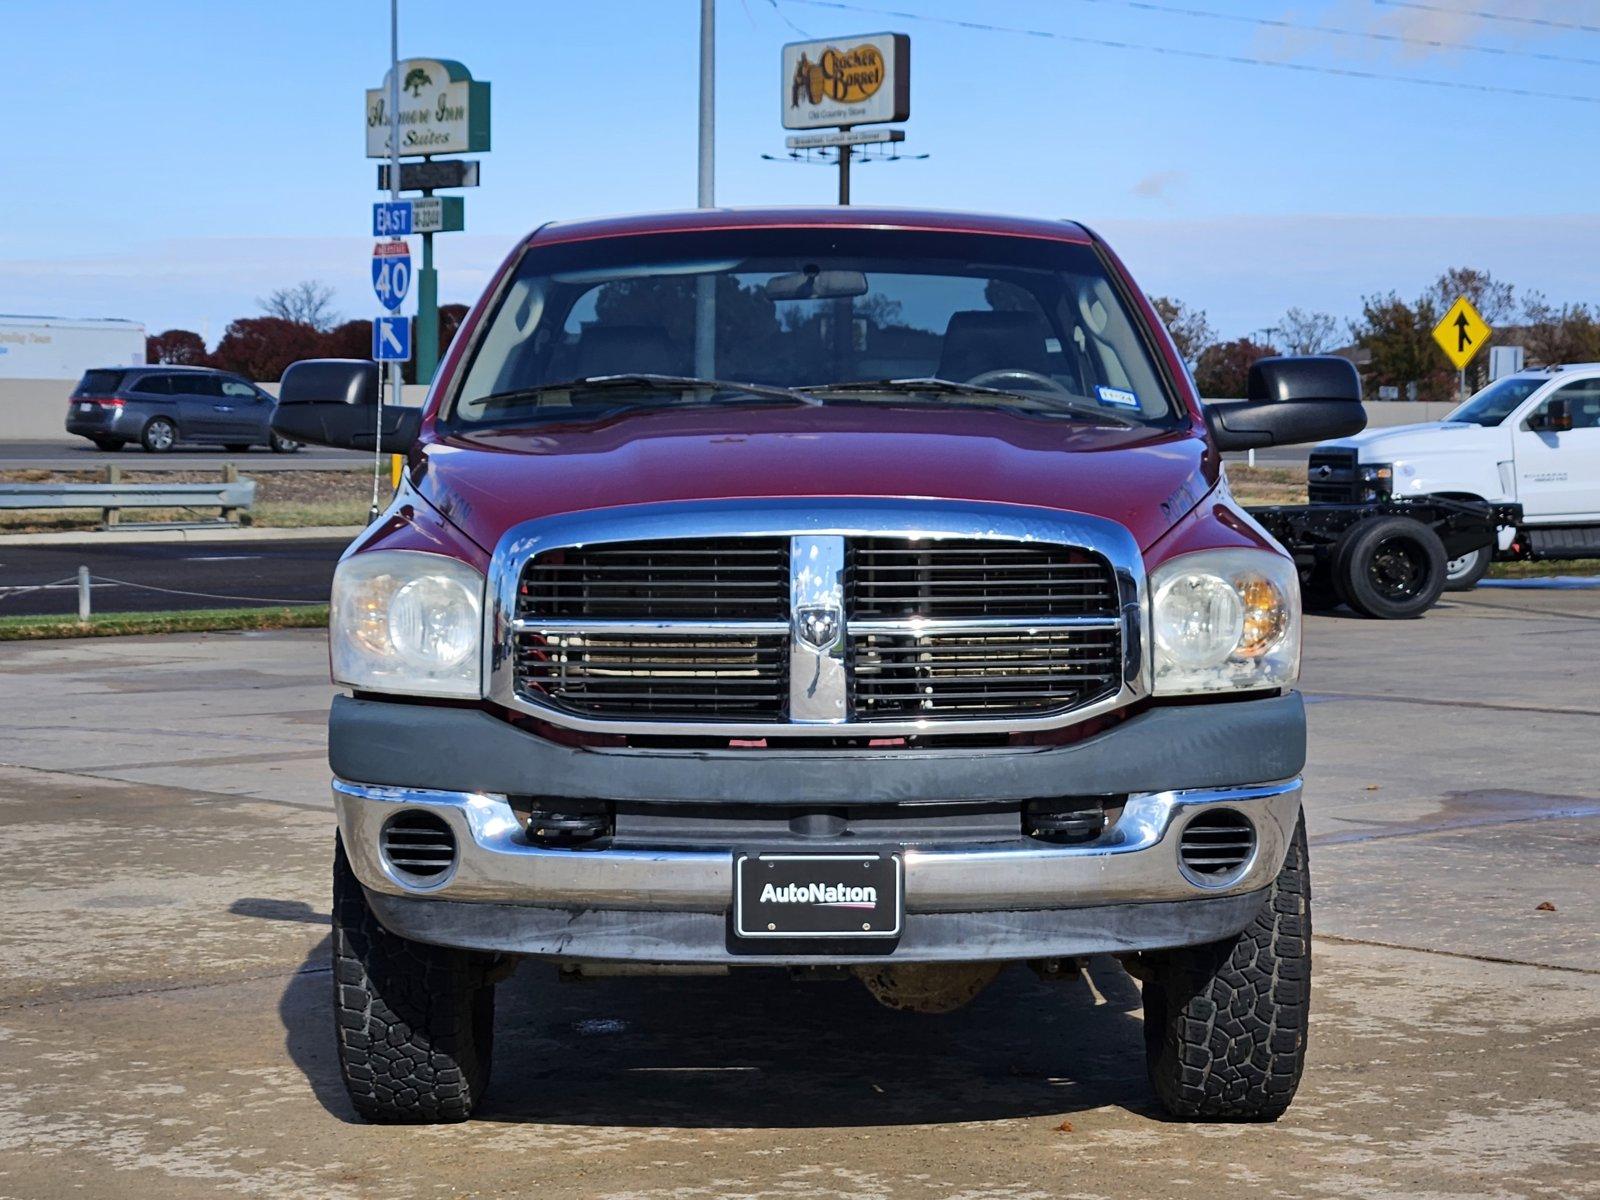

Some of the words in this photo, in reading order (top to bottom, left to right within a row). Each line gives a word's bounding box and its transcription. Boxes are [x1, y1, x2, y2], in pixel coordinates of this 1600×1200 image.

[821, 48, 876, 79] Cracker
[832, 67, 879, 100] Barrel
[435, 92, 466, 123] Inn
[821, 108, 847, 120] Country
[848, 107, 867, 117] Store
[402, 128, 450, 148] Suites
[377, 208, 407, 231] EAST
[375, 263, 408, 298] 40
[759, 882, 877, 903] AutoNation
